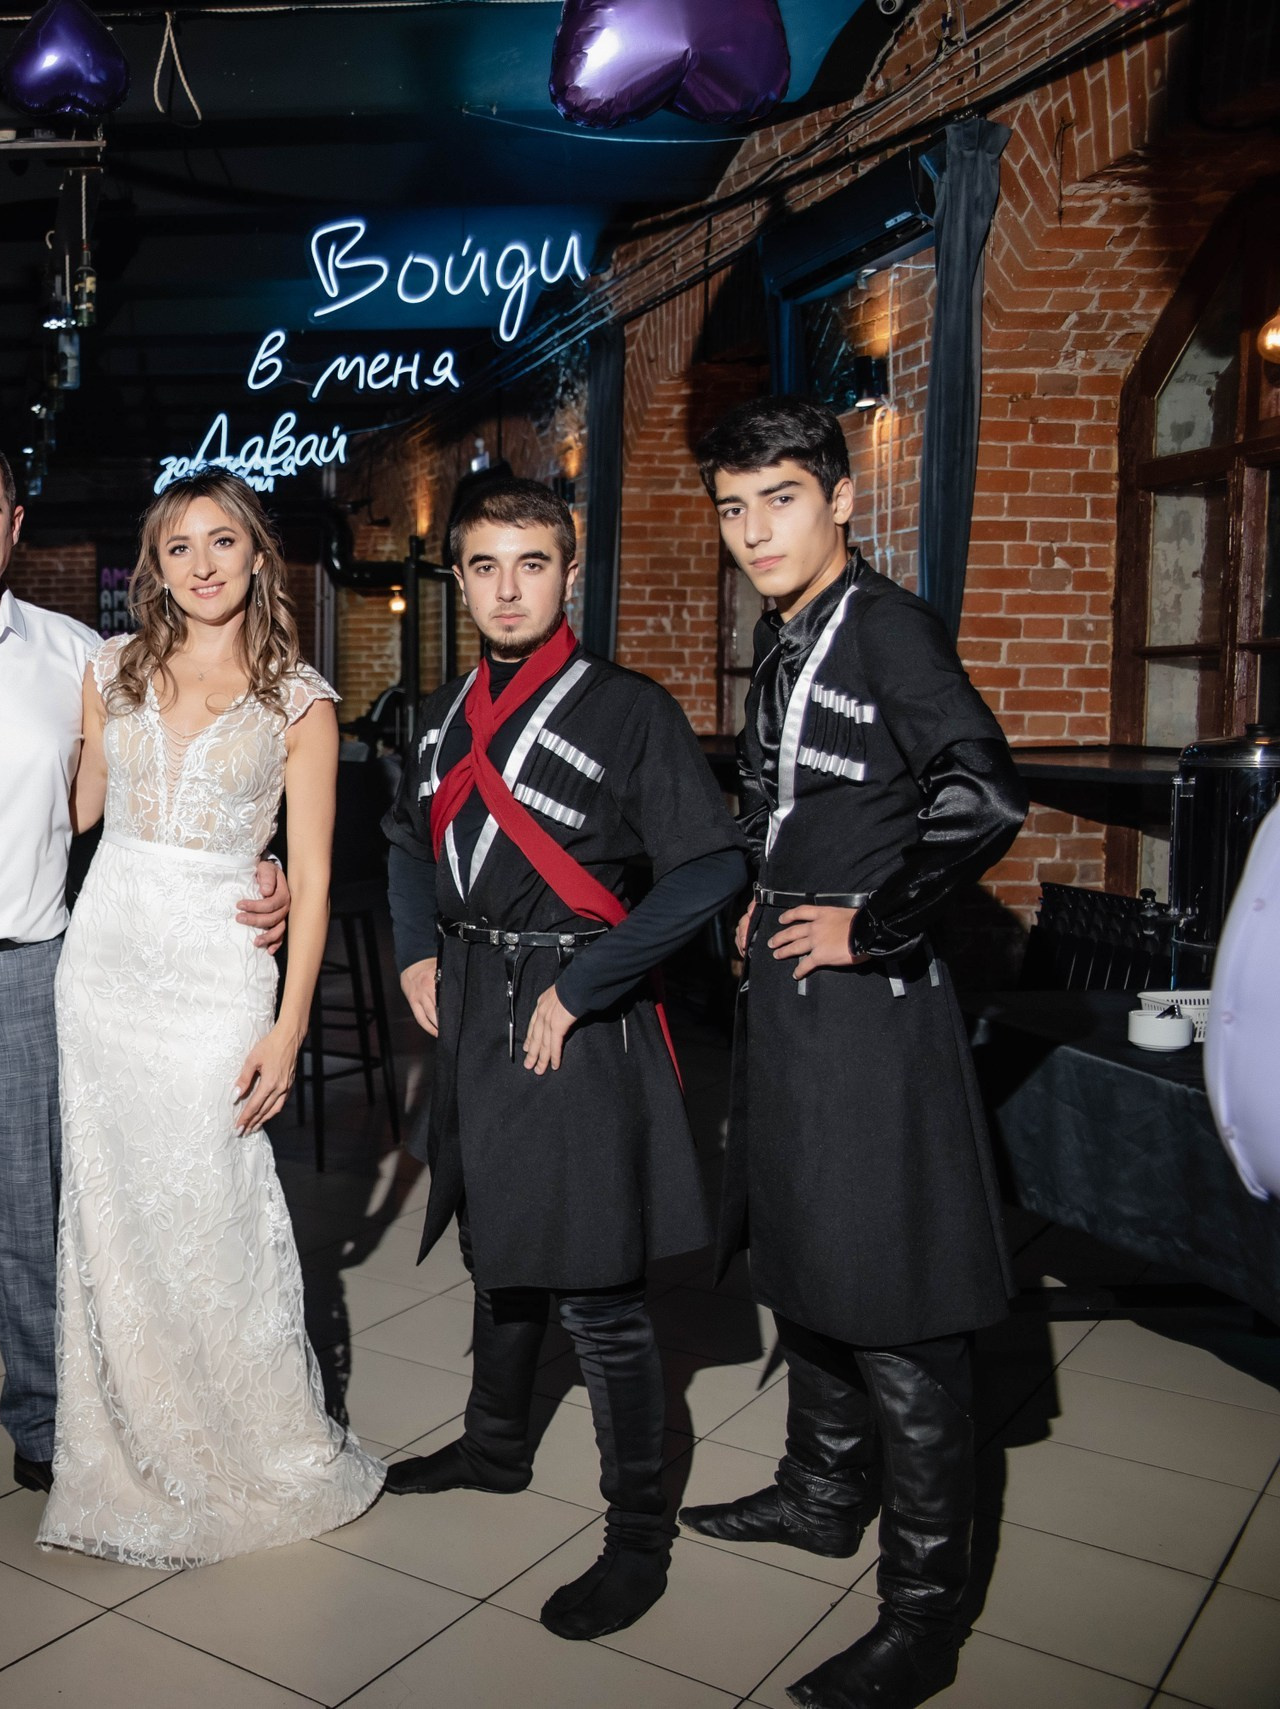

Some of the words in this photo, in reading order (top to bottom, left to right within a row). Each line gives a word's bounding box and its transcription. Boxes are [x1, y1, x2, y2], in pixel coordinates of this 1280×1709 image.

[311, 217, 588, 342] Войди
[247, 329, 287, 391] в
[312, 350, 460, 398] меня
[190, 412, 348, 470] Давай
